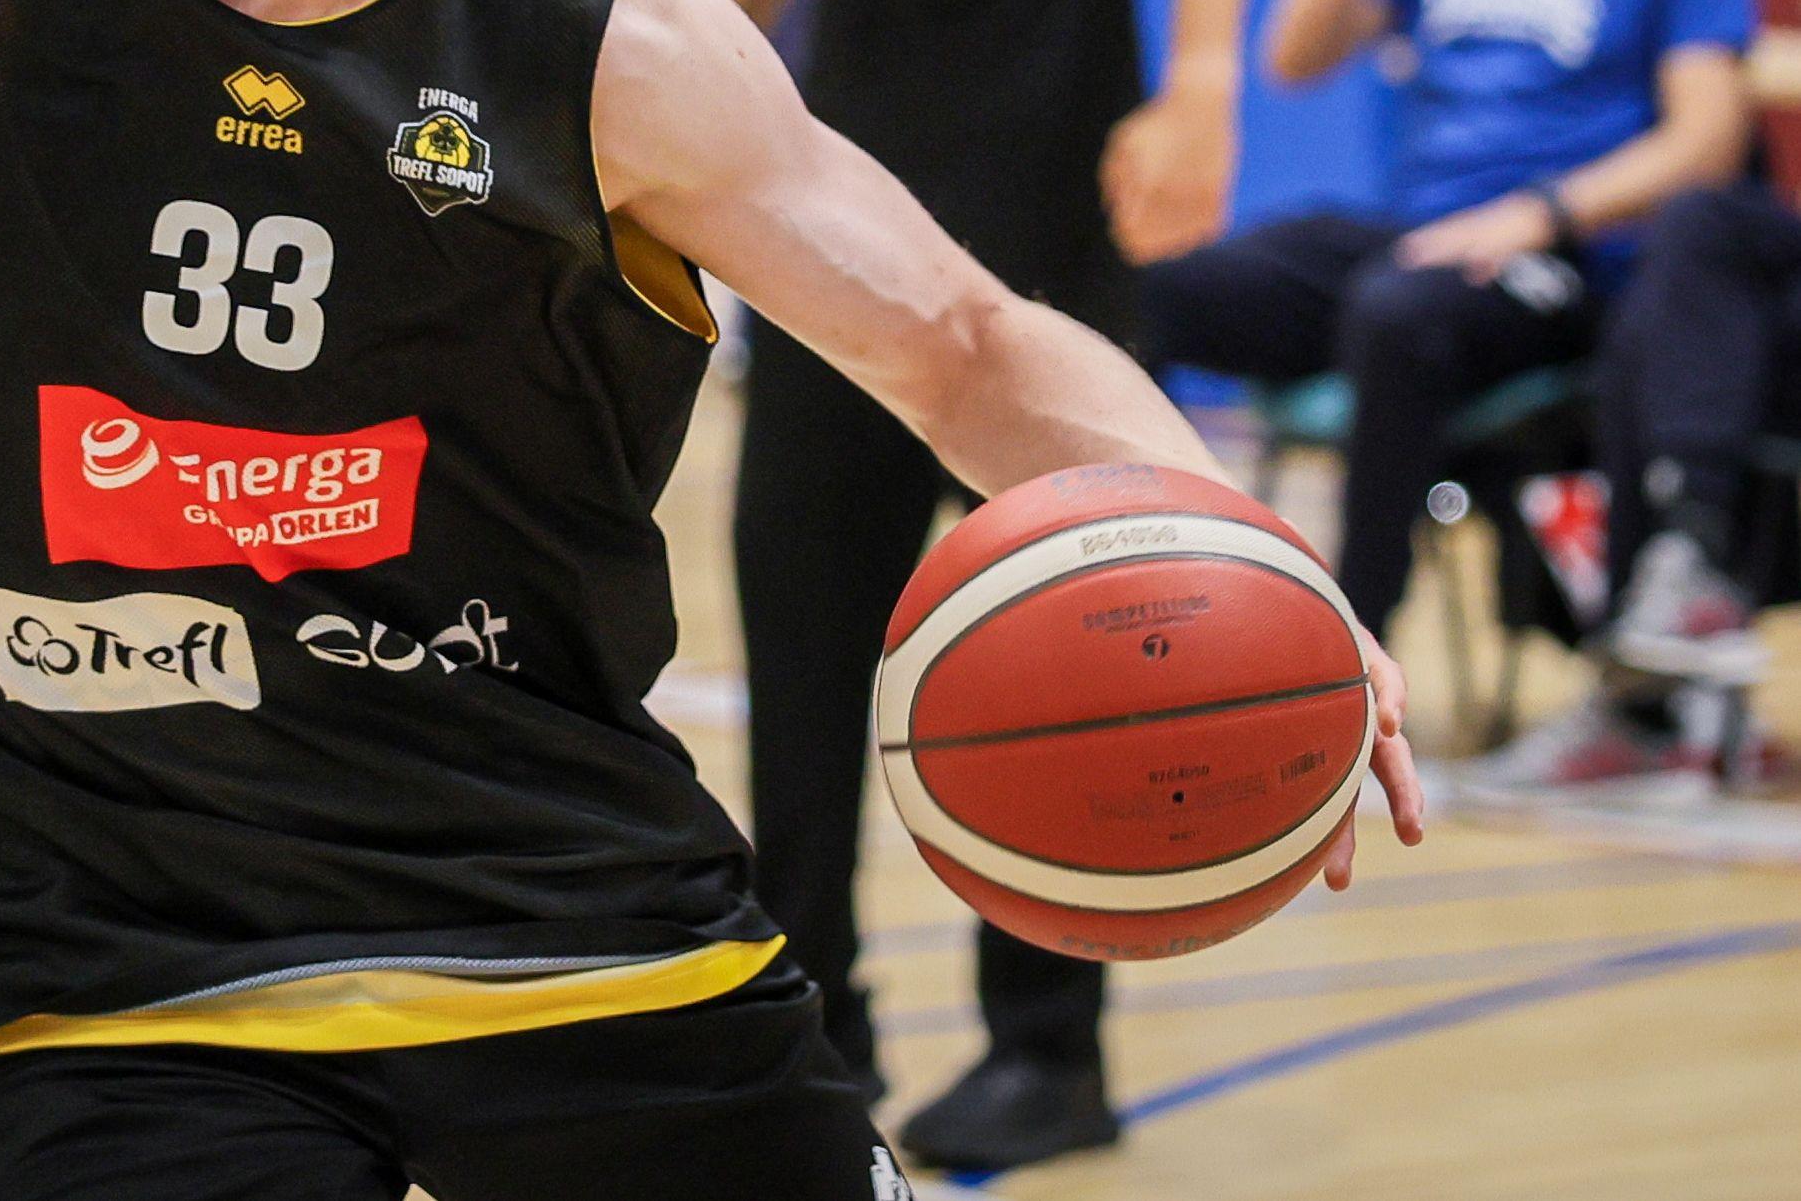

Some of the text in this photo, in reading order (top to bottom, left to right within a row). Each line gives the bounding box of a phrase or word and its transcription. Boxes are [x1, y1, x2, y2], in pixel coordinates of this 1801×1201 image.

[418, 87, 480, 124] ENERGA
[215, 114, 304, 155] errea
[392, 154, 487, 196] TREFL SOPOT
[142, 199, 334, 372] 33
[276, 502, 374, 540] ORLEN
[74, 621, 229, 688] Trefl
